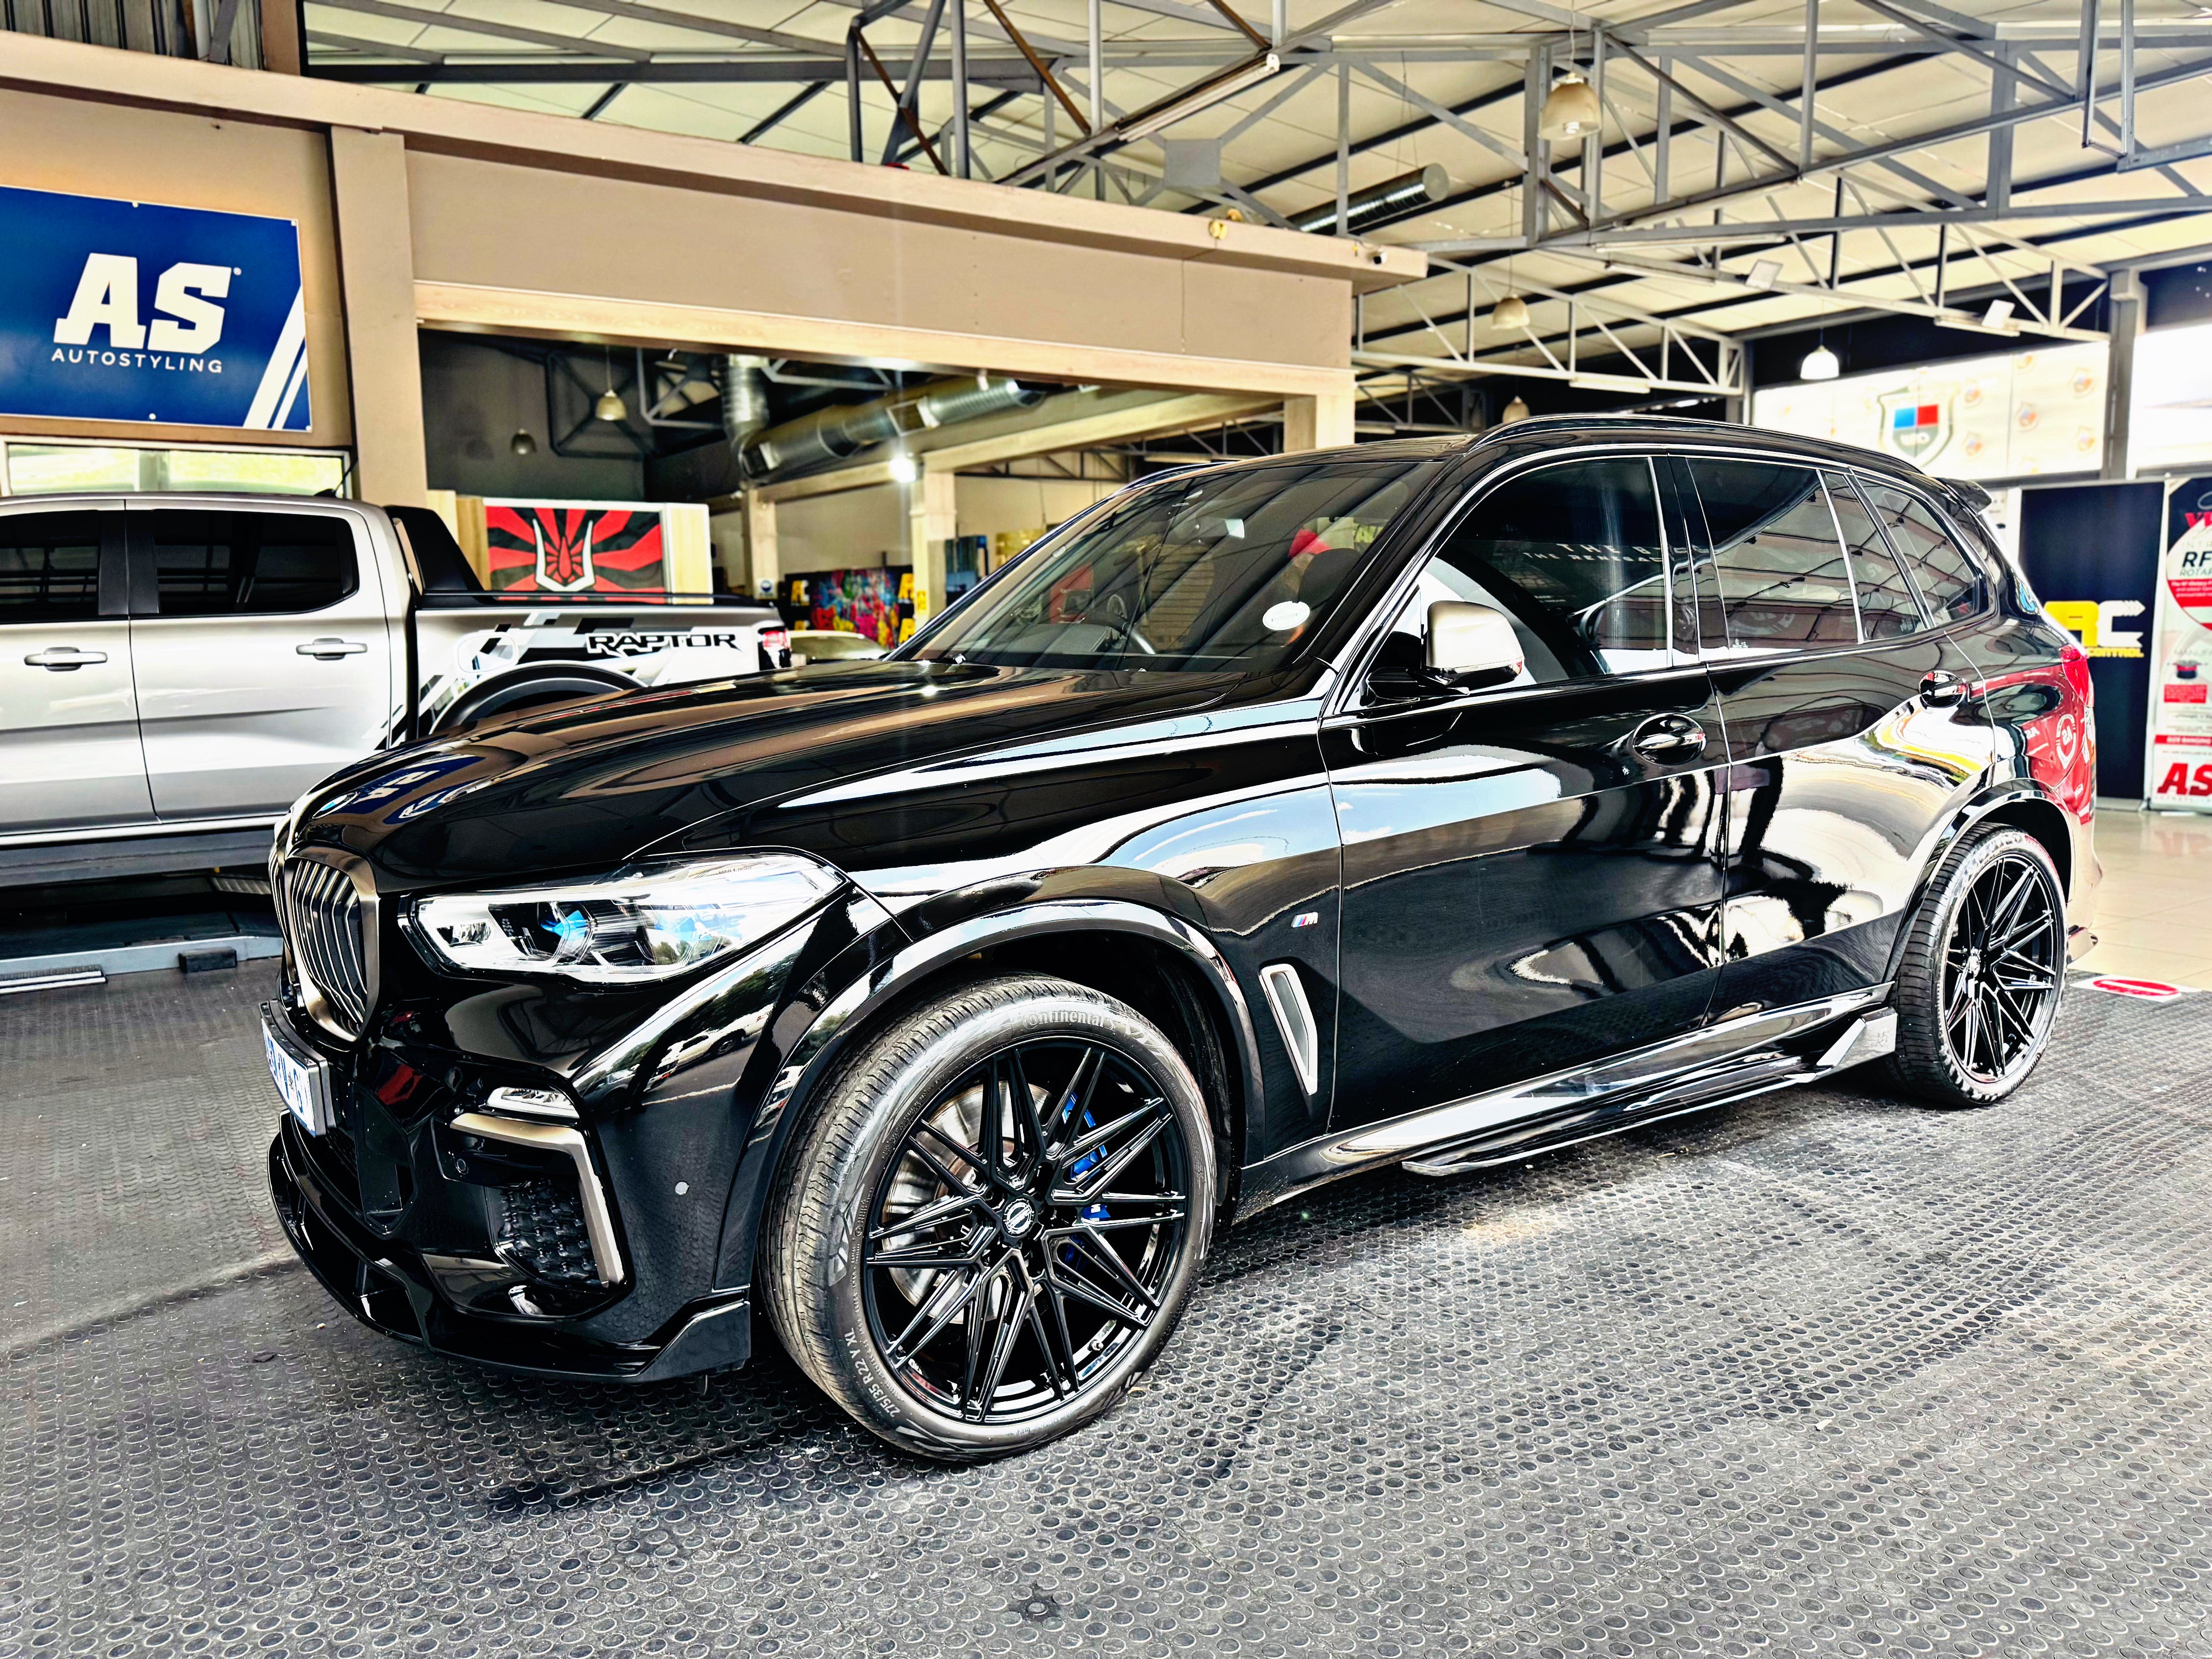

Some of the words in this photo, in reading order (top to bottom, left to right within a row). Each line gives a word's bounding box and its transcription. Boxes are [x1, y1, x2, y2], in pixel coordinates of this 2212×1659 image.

[51, 348, 222, 373] AUTOSTYLING
[1556, 544, 1621, 554] THE
[587, 633, 744, 656] RAPTOR
[1023, 1010, 1105, 1030] Continental
[844, 1327, 858, 1347] XL
[868, 1383, 901, 1417] 275/35
